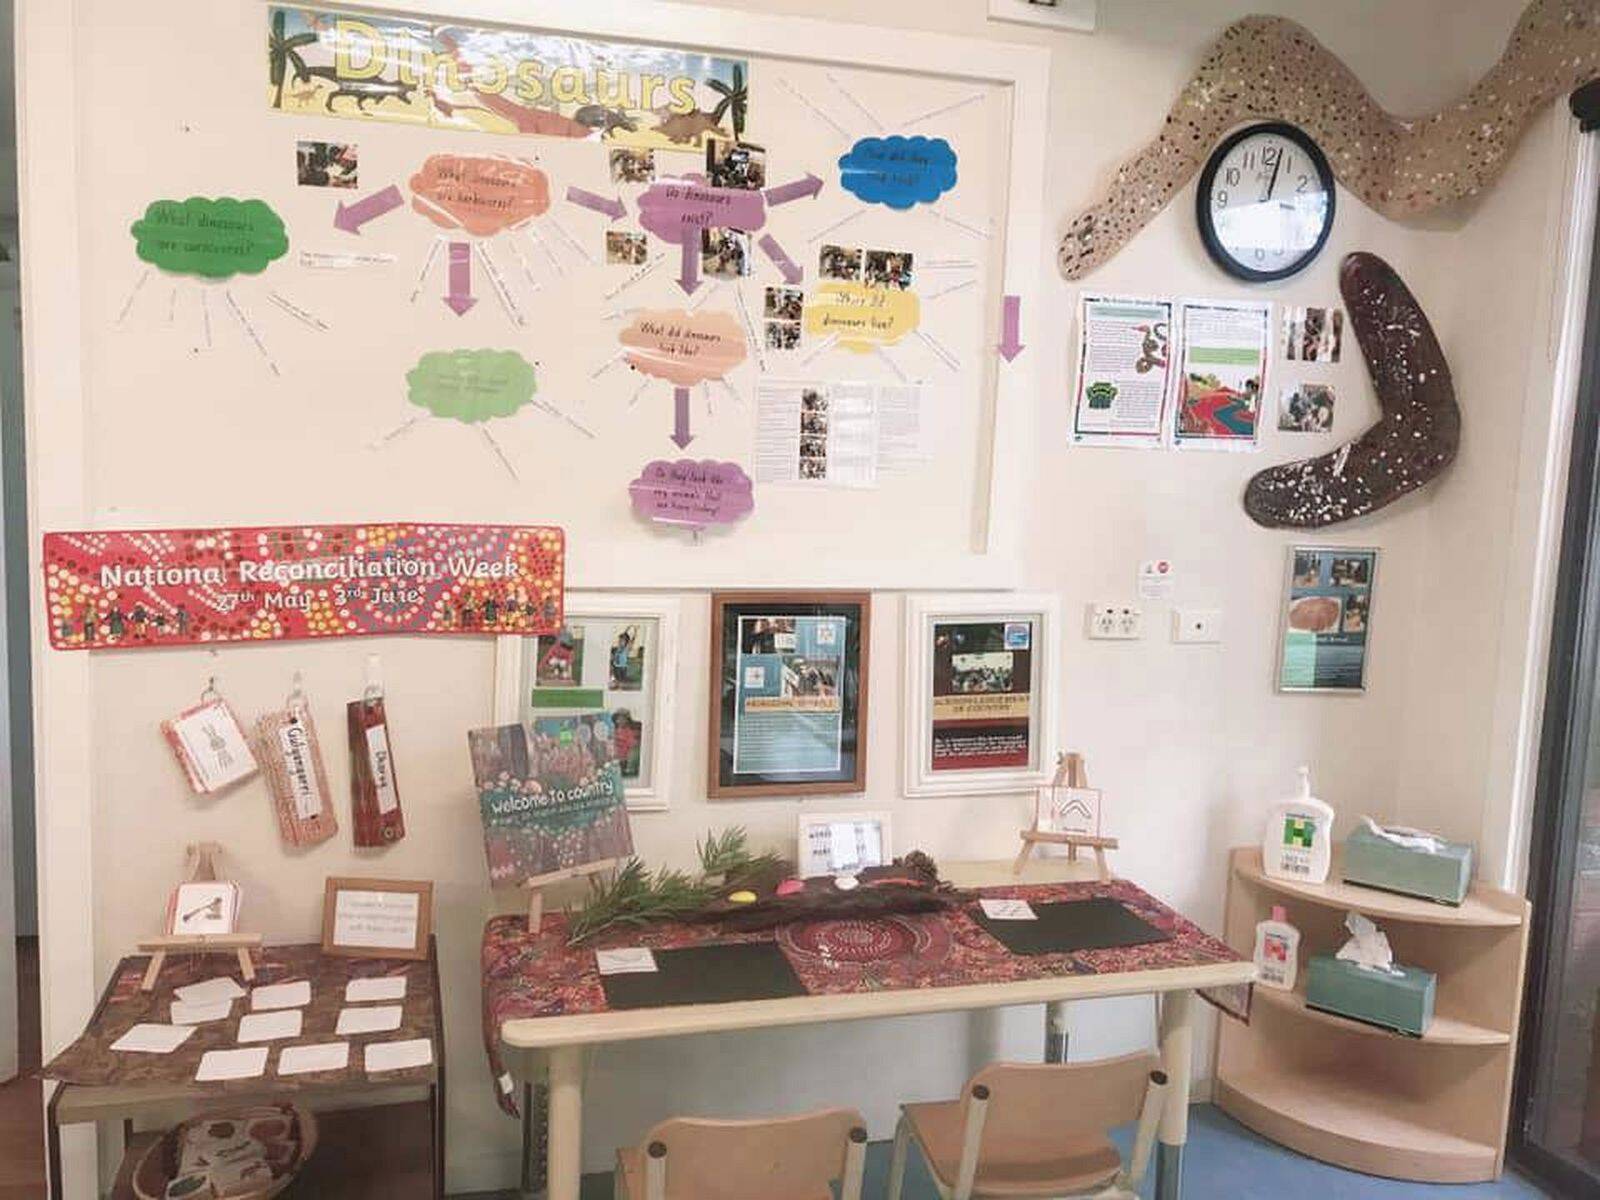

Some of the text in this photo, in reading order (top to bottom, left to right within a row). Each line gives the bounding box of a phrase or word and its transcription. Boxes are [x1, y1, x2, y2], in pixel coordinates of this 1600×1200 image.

[336, 20, 697, 113] Dinosaurs
[1243, 152, 1255, 170] 11
[1262, 146, 1276, 165] 12
[1226, 168, 1240, 187] 10
[1296, 175, 1308, 193] 2
[1216, 190, 1228, 209] 9
[100, 555, 520, 589] National Reconciliation Week
[263, 591, 312, 613] May
[370, 587, 421, 604] June
[491, 794, 548, 814] welcome
[567, 779, 614, 801] country
